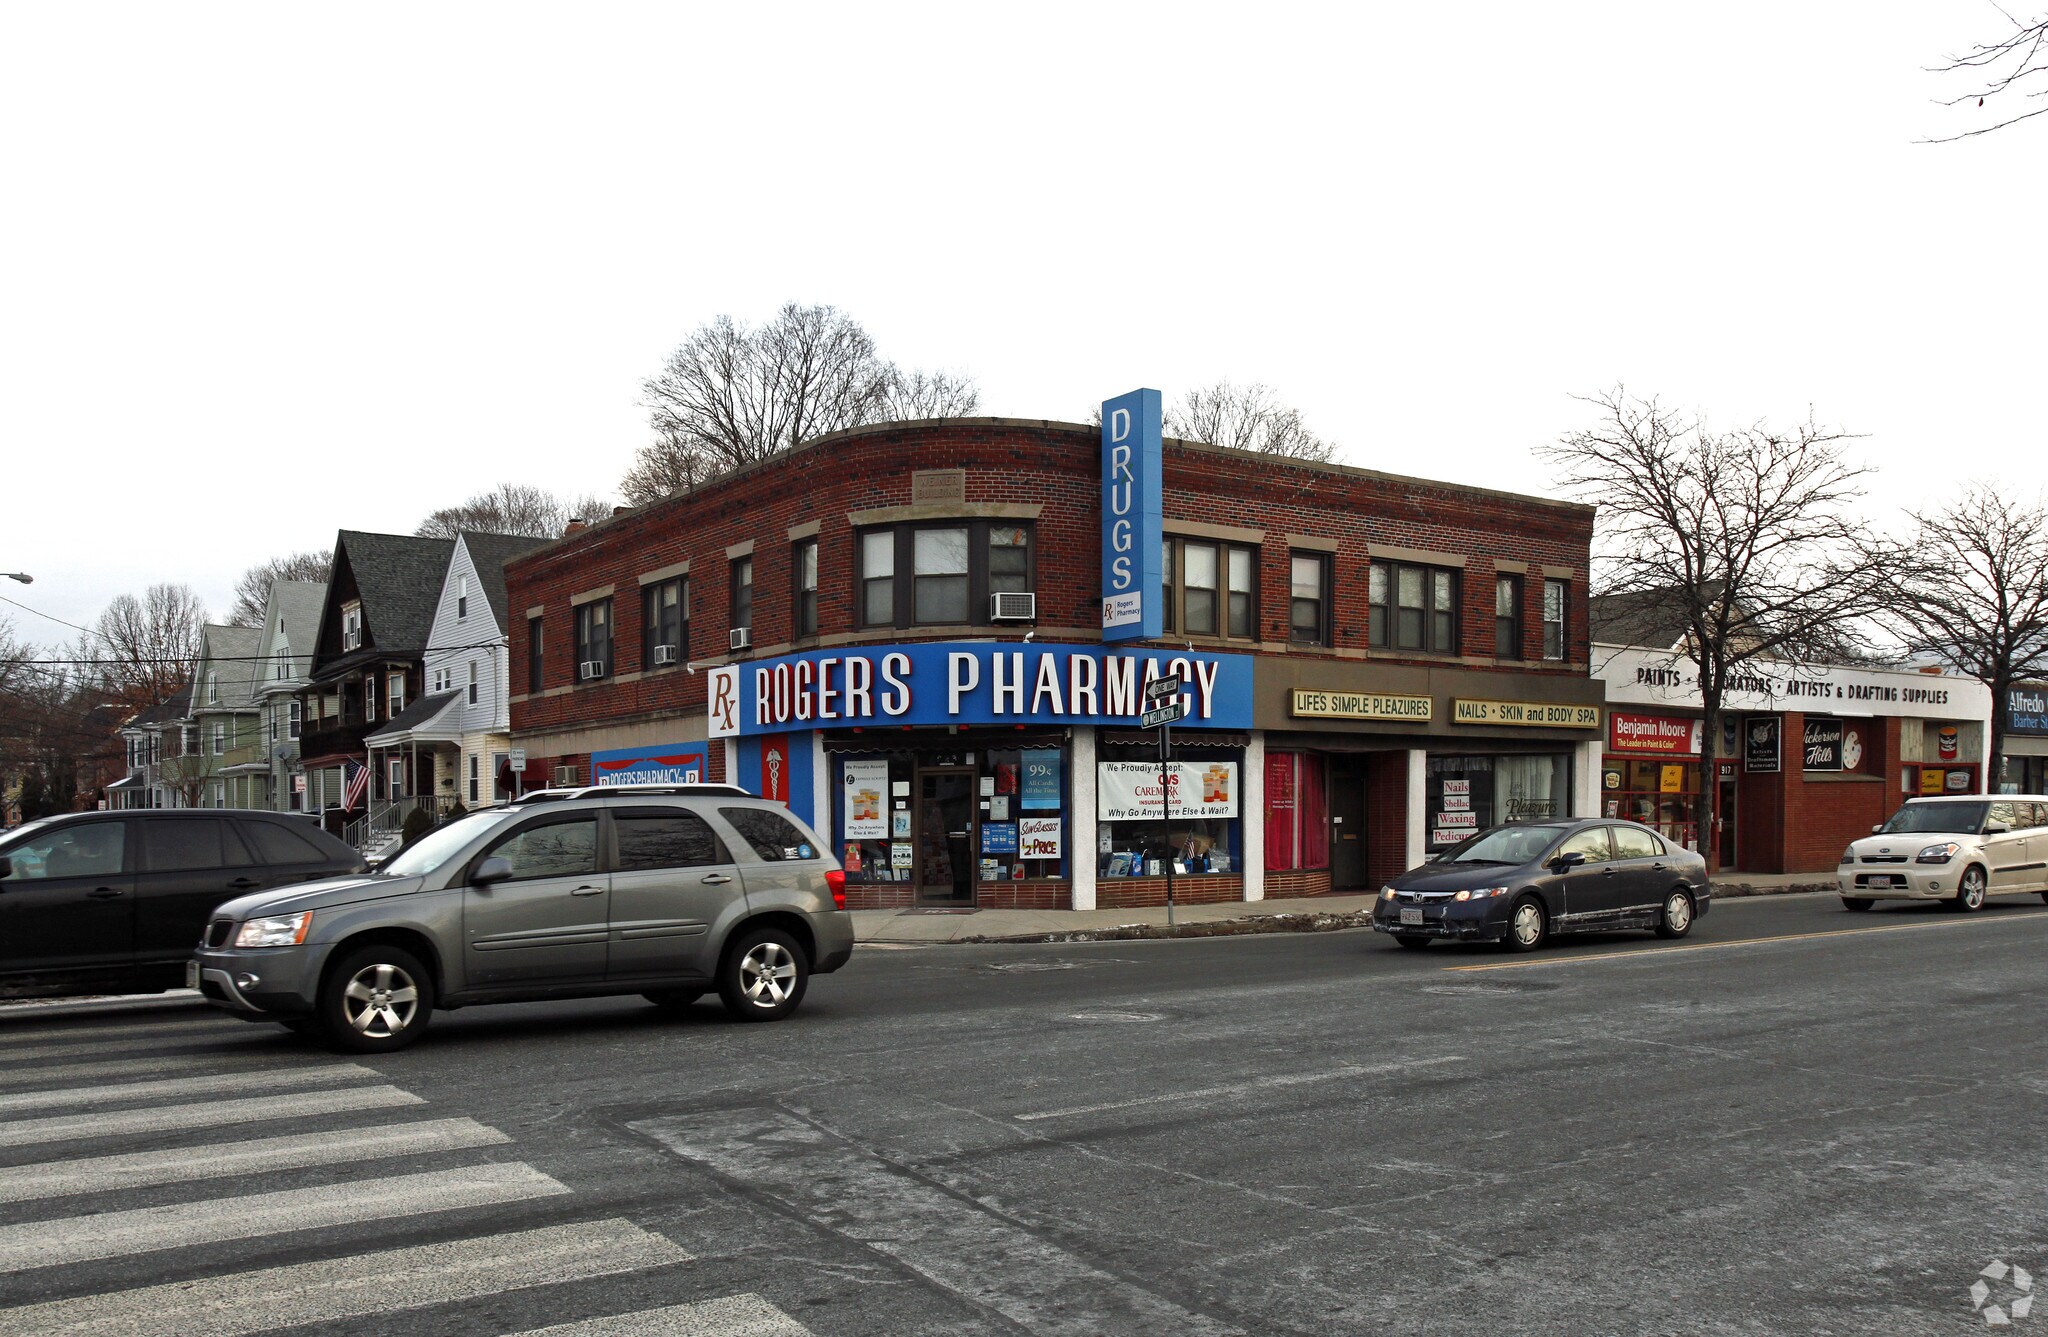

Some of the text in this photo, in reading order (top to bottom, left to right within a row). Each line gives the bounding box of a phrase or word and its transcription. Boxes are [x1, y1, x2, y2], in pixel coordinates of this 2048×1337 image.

[918, 487, 960, 499] BUILDING
[1111, 408, 1134, 589] DRUGS
[1116, 609, 1140, 617] Pharmacy
[755, 651, 1219, 725] ROGERS PHARMACY
[1155, 680, 1176, 694] ONE WAY
[1637, 668, 1681, 687] PAINTS
[1697, 673, 1773, 694] ORATORS
[1837, 687, 1843, 699] &
[1848, 684, 1898, 702] DRAFTING
[1902, 687, 1949, 705] SUPPLIES
[1297, 693, 1429, 716] LIFE'S SIMPLE PLEAZURES
[2008, 691, 2045, 713] Alfredo
[1458, 703, 1596, 723] NAILS SKIN and BODY SPA
[2013, 712, 2039, 728] Barber
[1617, 717, 1686, 738] Benjamin Moore
[1617, 738, 1627, 747] The
[1627, 738, 1642, 748] Leader
[1642, 739, 1647, 748] in
[1647, 739, 1659, 748] Paint
[1806, 745, 1833, 765] Hills
[1029, 764, 1053, 777] 99¢
[1106, 763, 1119, 771] We
[1721, 765, 1731, 774] 917
[637, 768, 681, 785] PHARMACY
[1134, 785, 1179, 799] CAREMRK
[1444, 782, 1469, 793] Nails
[1444, 799, 1469, 808] Shellac
[1108, 806, 1229, 818] Why Go Anywere Else & Wait?
[1439, 813, 1475, 826] Waxing
[1434, 831, 1473, 841] Pedicur
[1033, 838, 1057, 854] PRICE
